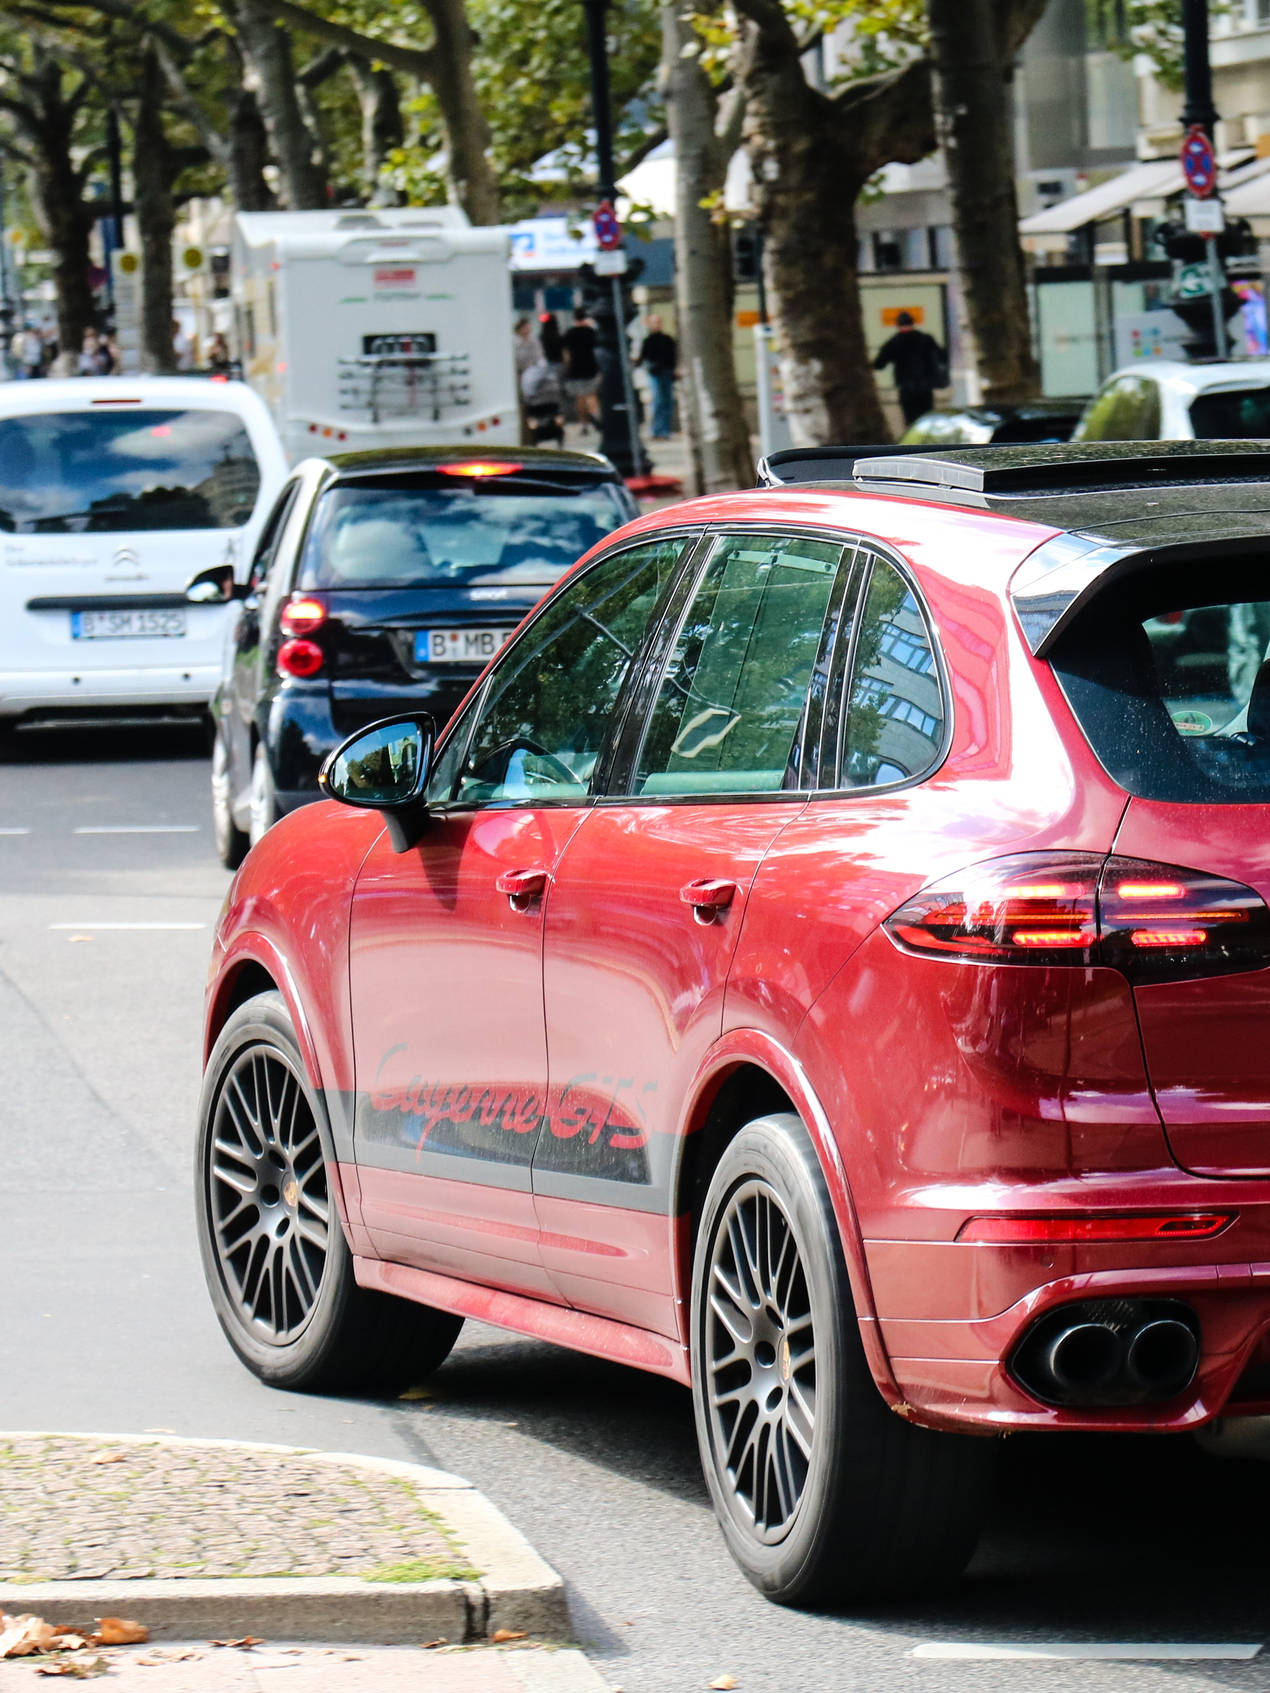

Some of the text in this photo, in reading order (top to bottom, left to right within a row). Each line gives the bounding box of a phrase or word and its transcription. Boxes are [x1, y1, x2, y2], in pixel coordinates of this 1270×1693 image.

[432, 634, 446, 656] B
[464, 633, 495, 656] MB
[370, 1042, 658, 1163] Cayenne GTS
